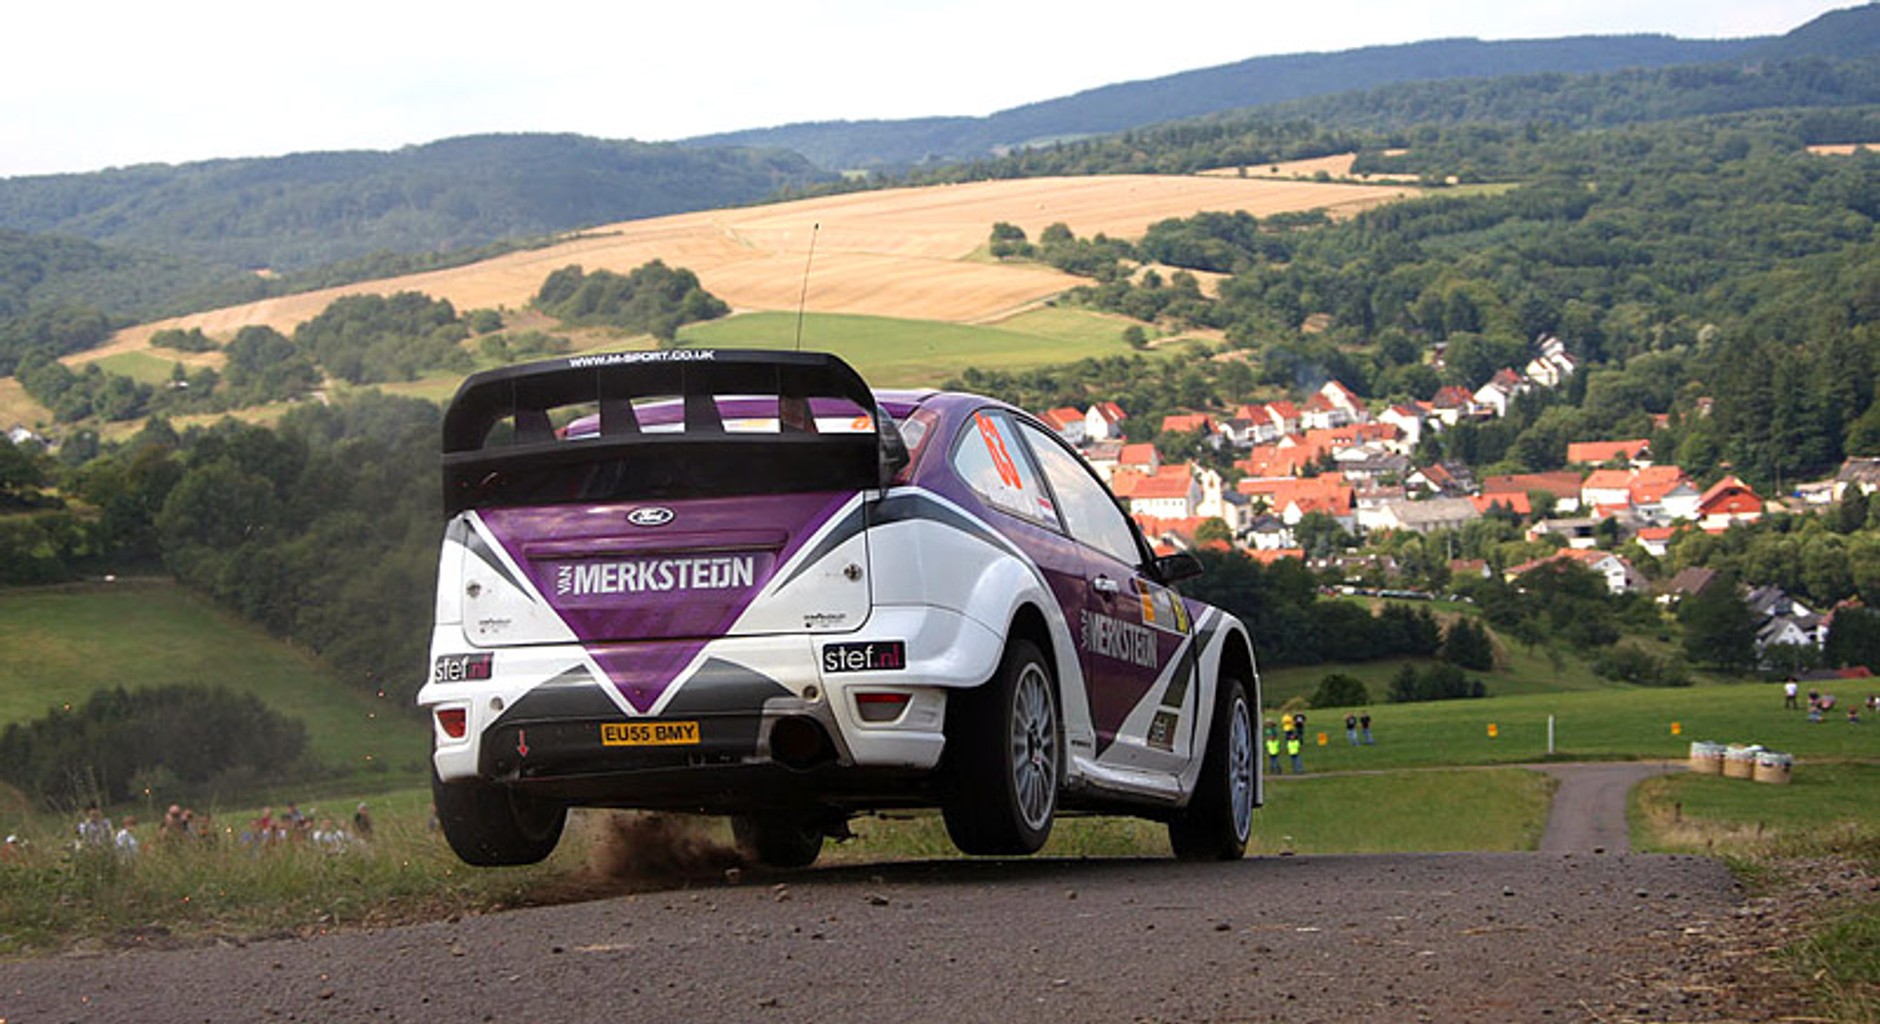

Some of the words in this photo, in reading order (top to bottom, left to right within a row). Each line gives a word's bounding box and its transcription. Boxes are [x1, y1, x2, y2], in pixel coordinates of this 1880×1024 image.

[569, 350, 715, 368] WWW.M-SPORT.CO.UK
[557, 565, 572, 595] VAN
[573, 556, 754, 596] MERKSTEIJN
[825, 643, 899, 671] stef.nl
[604, 726, 650, 741] EU55
[656, 724, 695, 740] BMY
